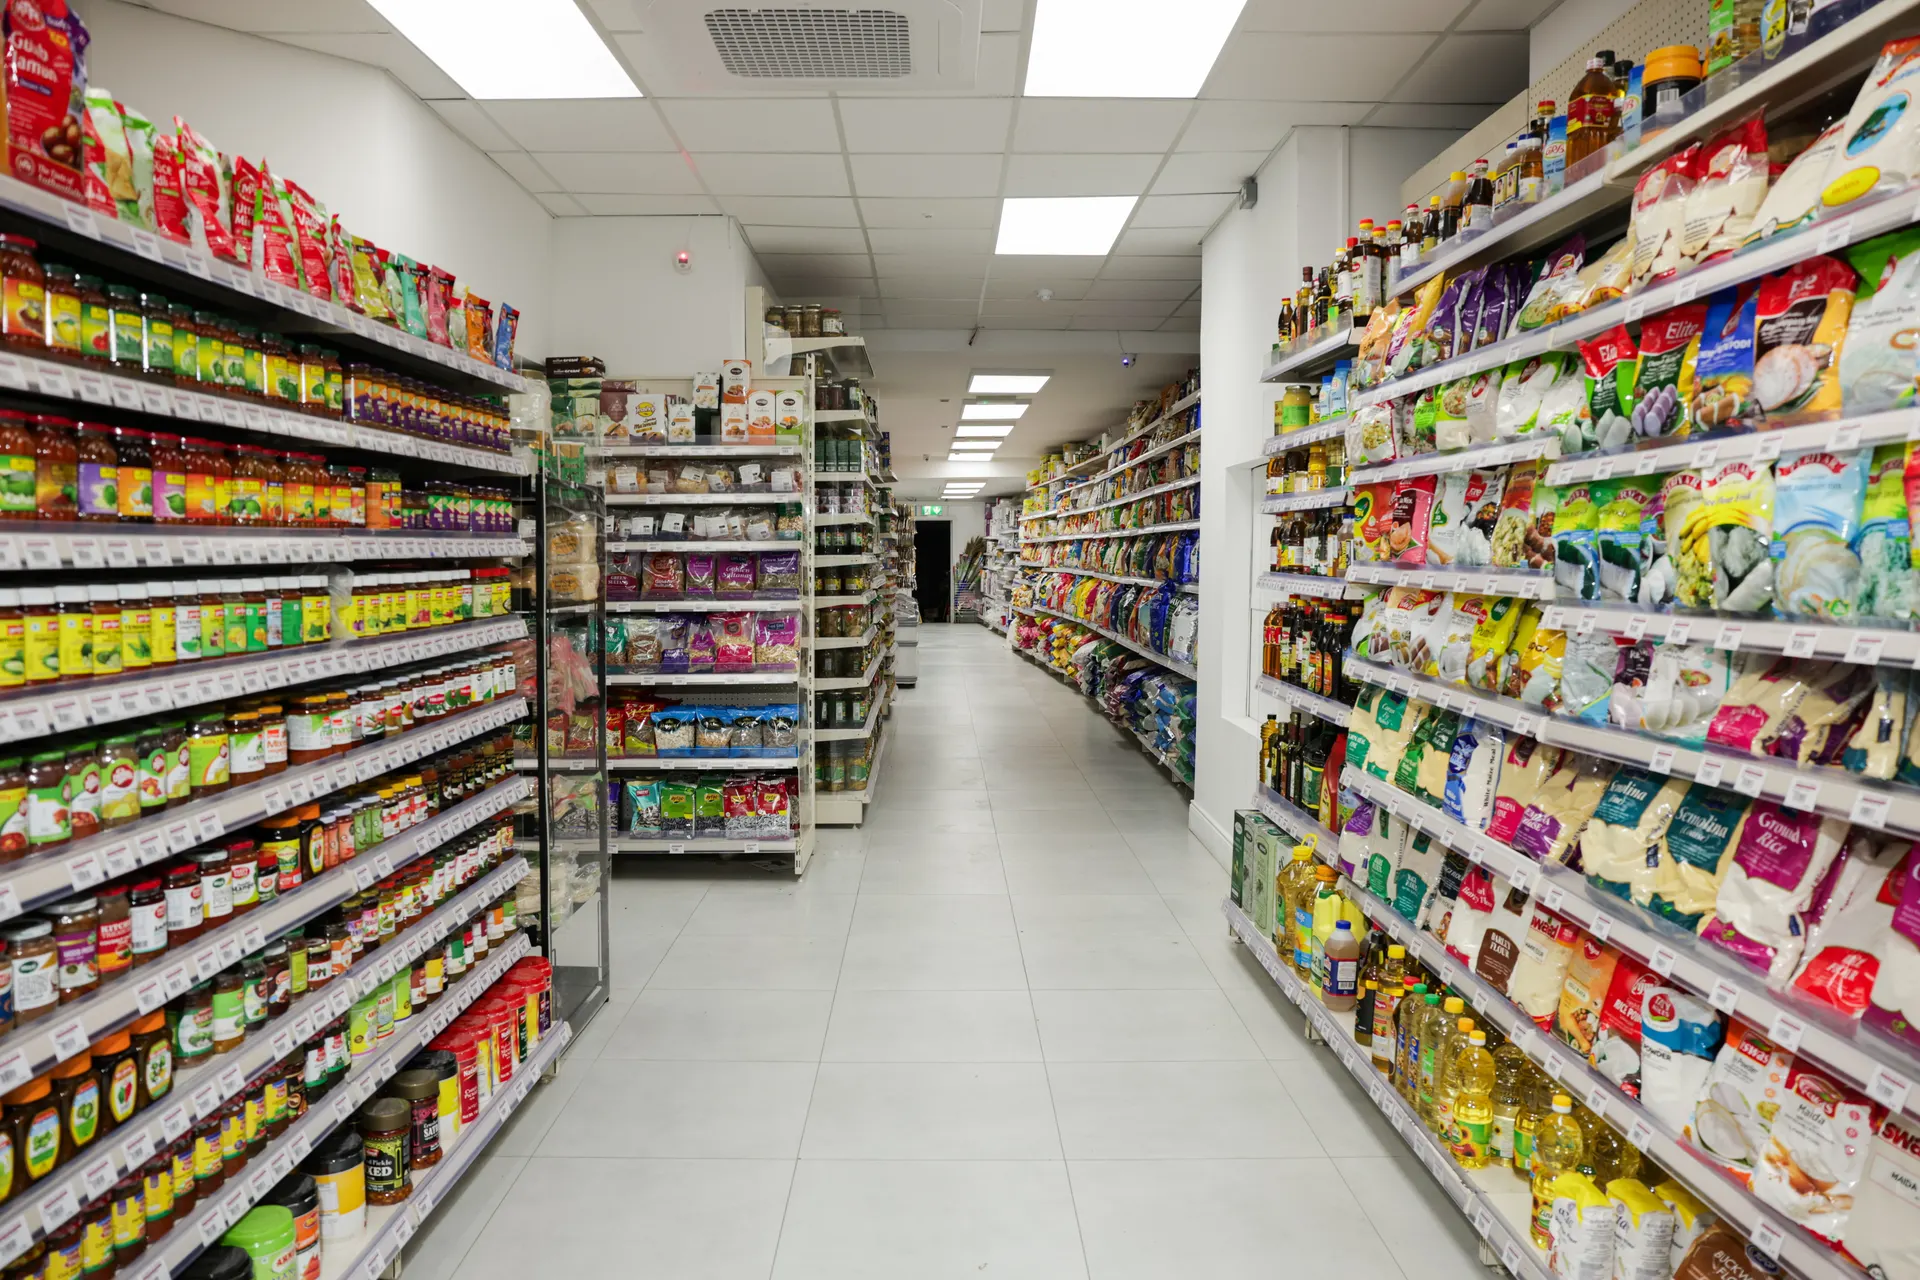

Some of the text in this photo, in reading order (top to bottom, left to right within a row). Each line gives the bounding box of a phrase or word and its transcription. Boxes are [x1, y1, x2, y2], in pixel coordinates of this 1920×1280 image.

[1666, 321, 1699, 339] Elite
[1483, 788, 1491, 807] White
[1610, 780, 1648, 801] Semolina
[1675, 807, 1729, 839] Semolina
[1758, 812, 1800, 844] Ground
[1755, 831, 1787, 855] Rice
[1489, 943, 1510, 959] FLOUR
[1613, 998, 1642, 1023] RICE POW
[1797, 1103, 1826, 1125] Maida
[1891, 1171, 1918, 1192] MAIDA
